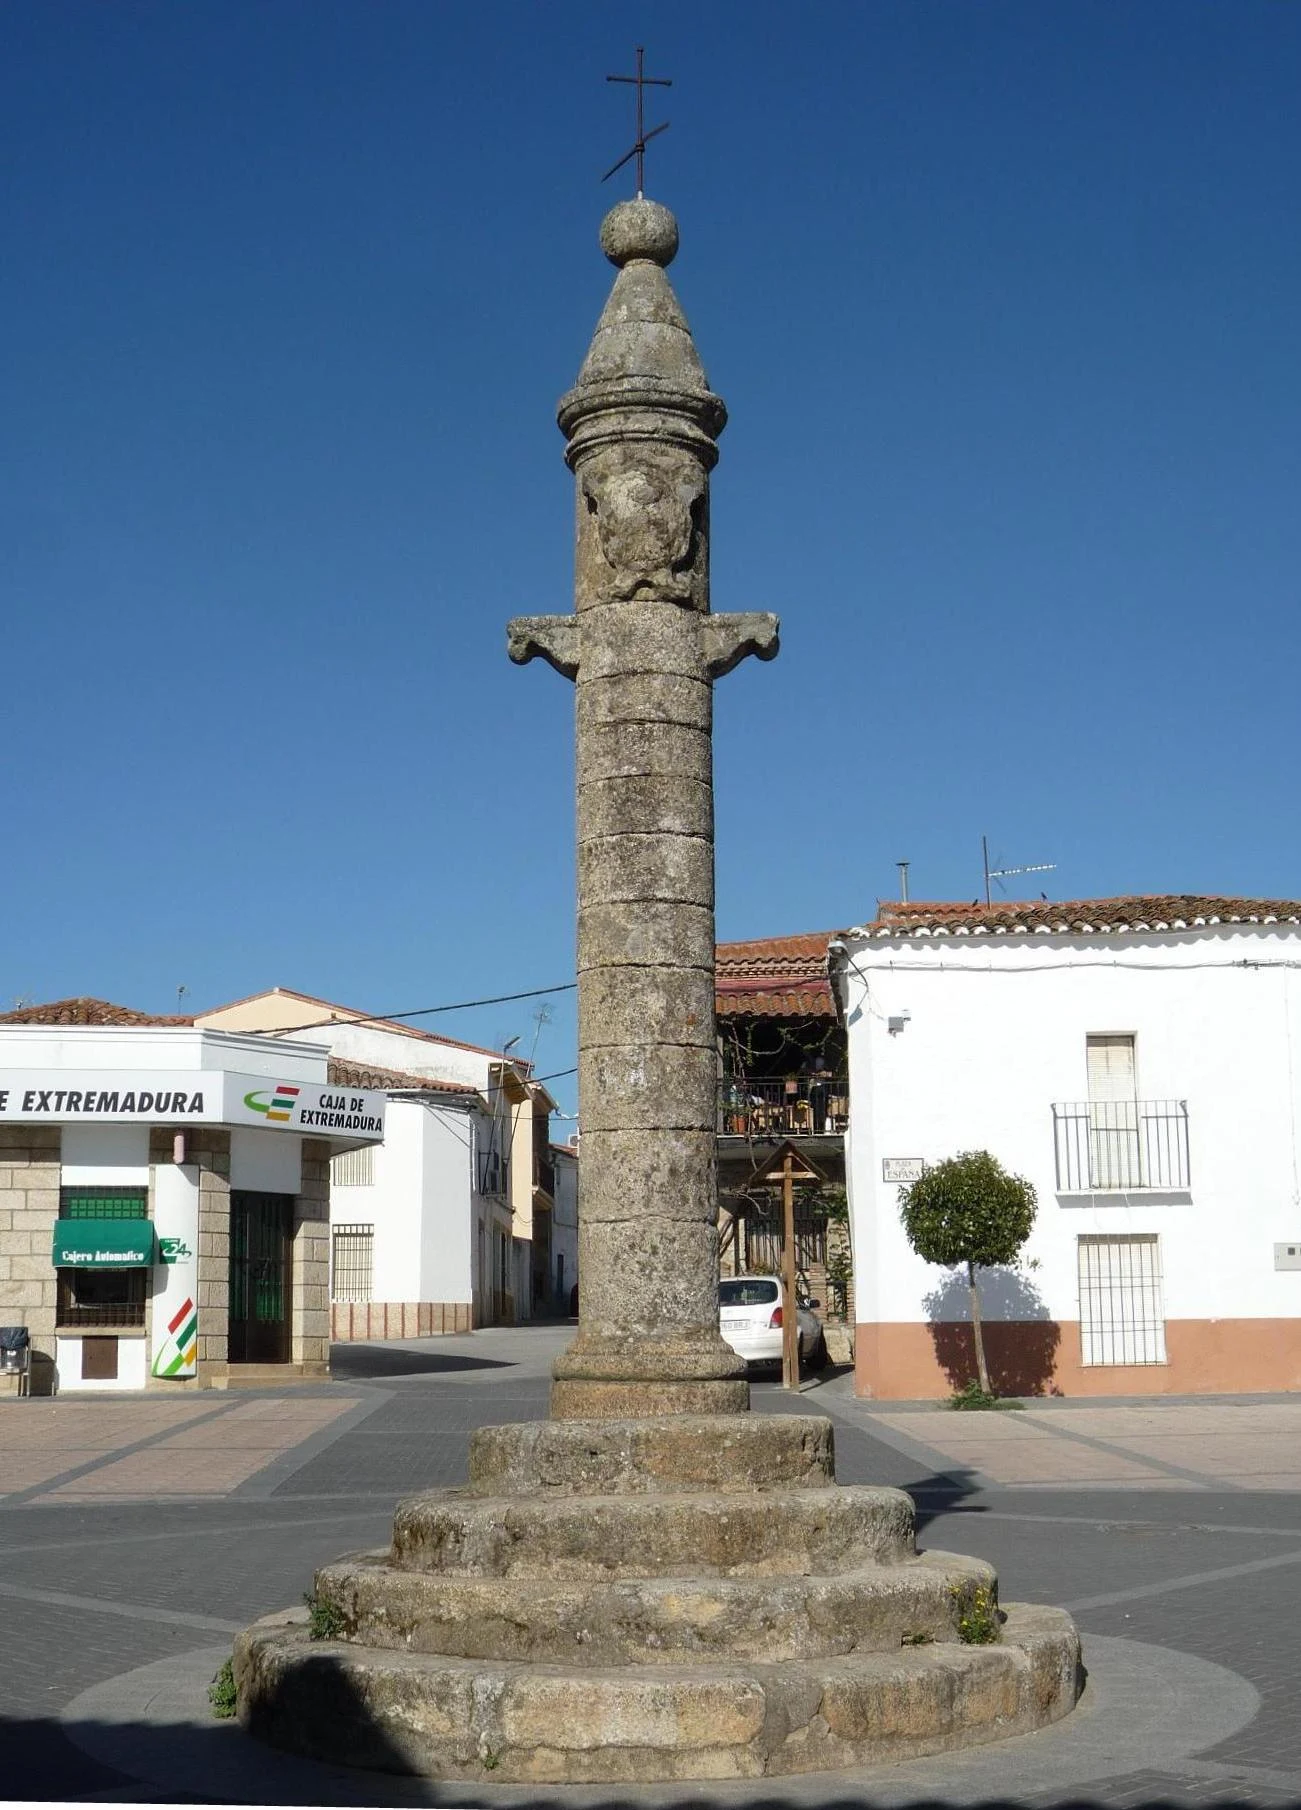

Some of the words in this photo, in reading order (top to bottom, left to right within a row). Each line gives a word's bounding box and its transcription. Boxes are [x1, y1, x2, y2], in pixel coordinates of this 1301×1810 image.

[22, 1090, 204, 1113] EXTREMADURA
[319, 1094, 346, 1110] CAJA
[350, 1098, 364, 1112] DE
[300, 1109, 382, 1132] EXTREMADURA
[62, 1250, 93, 1264] Cajero
